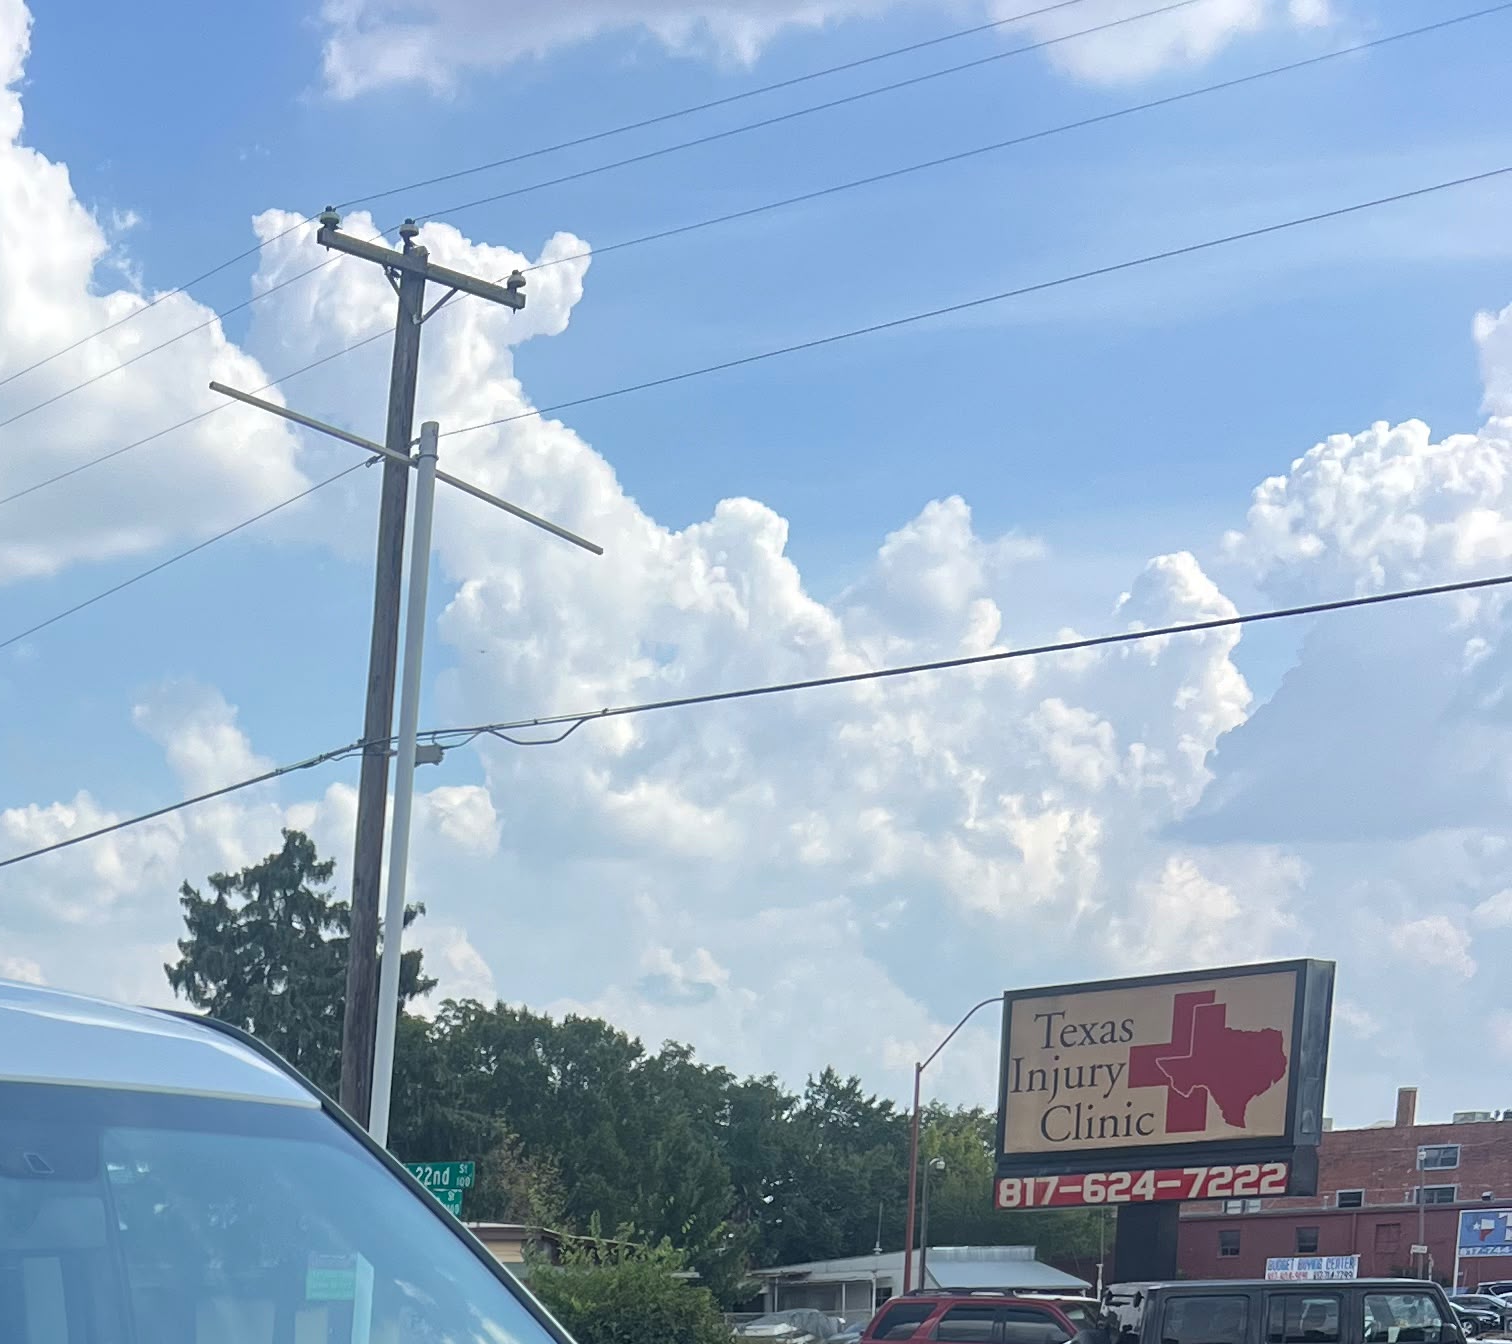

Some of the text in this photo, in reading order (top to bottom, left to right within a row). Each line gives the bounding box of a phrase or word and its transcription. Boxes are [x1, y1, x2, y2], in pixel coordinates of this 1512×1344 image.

[1034, 1010, 1134, 1050] Texas
[1009, 1054, 1127, 1104] Injury
[1040, 1100, 1155, 1142] Clinic
[415, 1163, 468, 1187] 22nd St
[998, 1161, 1288, 1208] 817-624-7222
[1325, 1256, 1355, 1270] CENTER
